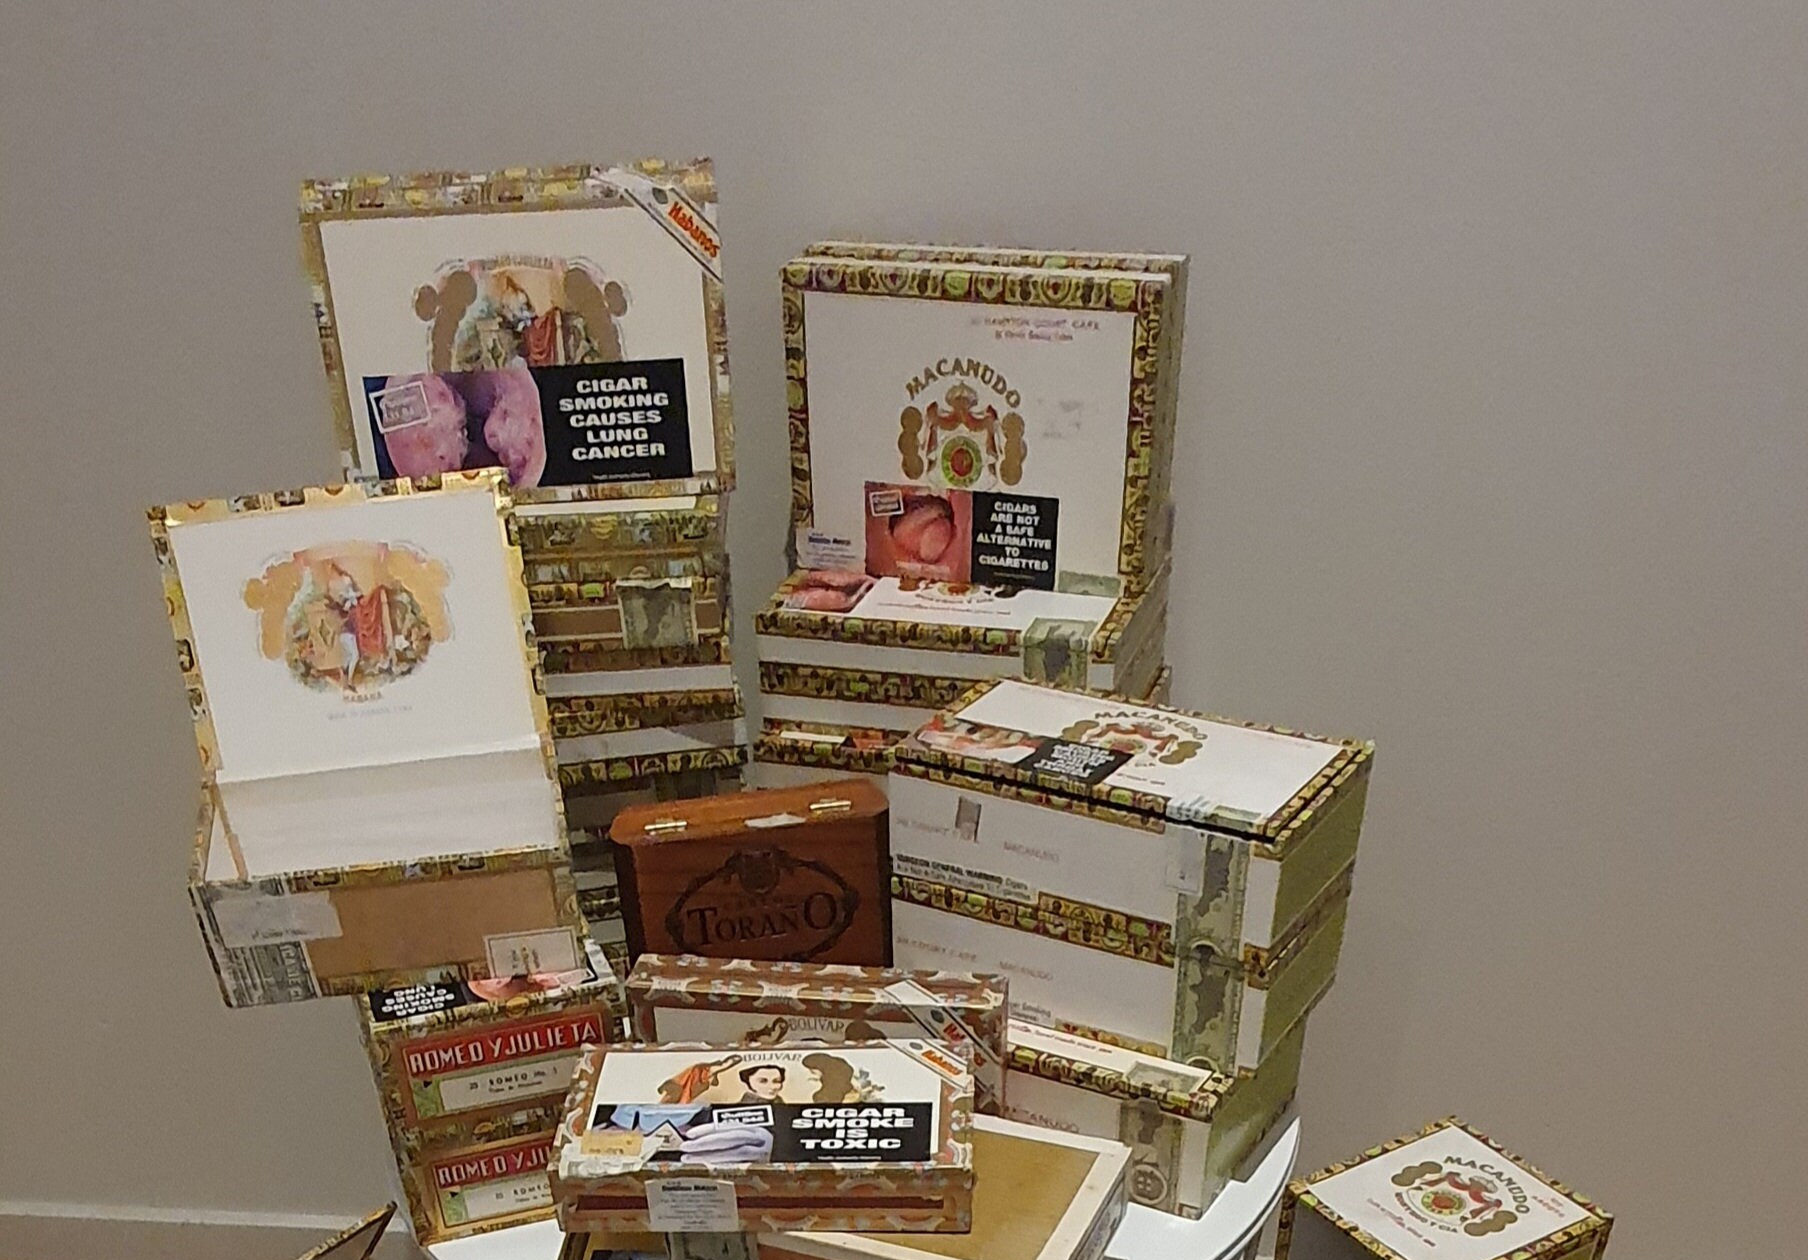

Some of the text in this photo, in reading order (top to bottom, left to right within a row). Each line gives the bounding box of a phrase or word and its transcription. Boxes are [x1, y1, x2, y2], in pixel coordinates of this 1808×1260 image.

[668, 201, 720, 257] Habanos
[576, 377, 648, 393] CIGAR
[905, 358, 1022, 410] MACANUDO
[559, 393, 669, 411] SMOKING
[570, 410, 662, 428] CAUSES
[586, 427, 648, 443] LUNG
[571, 443, 665, 460] CANCER
[994, 501, 1037, 515] CIGARS
[990, 513, 1040, 526] ARE NOT
[995, 524, 1034, 537] A SAFE
[976, 532, 1052, 550] ALTERNATIVE
[1004, 547, 1020, 557] TO
[979, 555, 1049, 571] CIGARETTES
[381, 993, 455, 1013] SMOKING
[385, 988, 447, 1005] CAUSES
[395, 1002, 445, 1017] CIGAR
[789, 1017, 844, 1032] BOLIVAR
[409, 1022, 597, 1073] ROMEO Y JULIETA
[744, 1053, 801, 1063] BOLIVAR
[801, 1108, 905, 1118] CIGAR
[791, 1118, 914, 1129] SMOKE
[835, 1128, 868, 1139] IS
[800, 1139, 902, 1149] TOXIC
[438, 1156, 507, 1185] ROMEO
[512, 1151, 523, 1169] Y
[1444, 1156, 1530, 1214] MACANUDO
